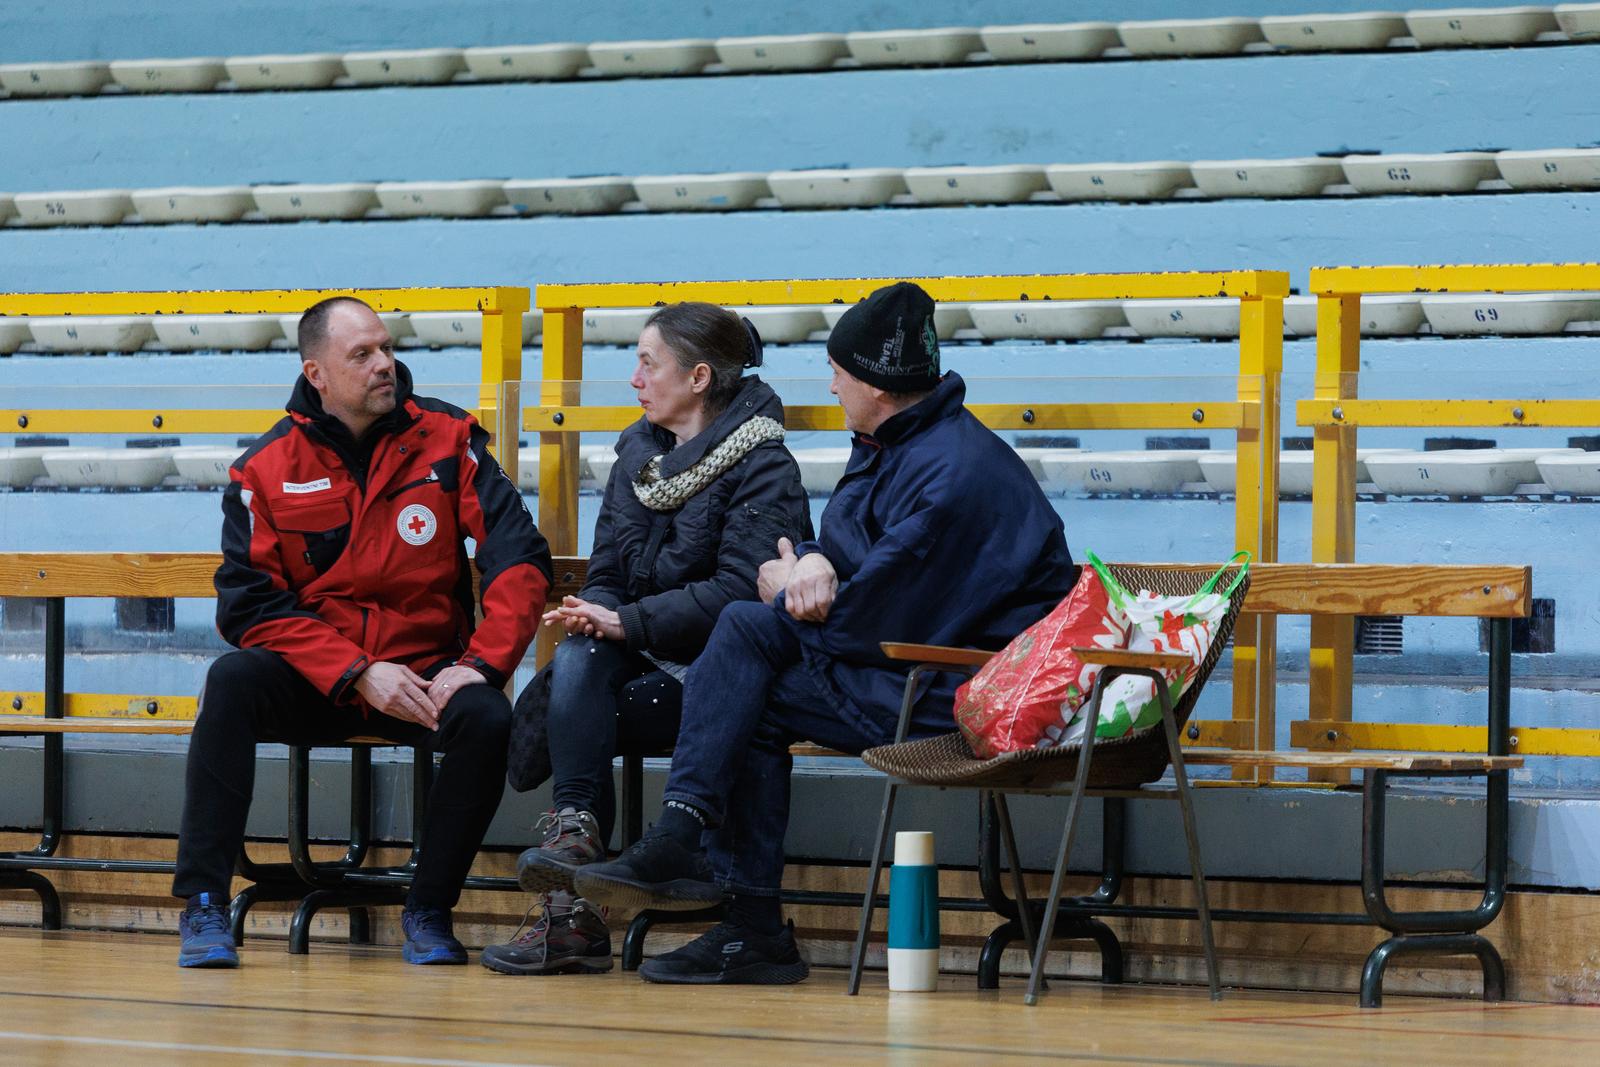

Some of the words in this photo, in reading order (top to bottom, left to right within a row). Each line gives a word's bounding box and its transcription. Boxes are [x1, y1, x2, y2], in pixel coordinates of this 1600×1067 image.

[1474, 308, 1498, 322] 69
[878, 337, 896, 366] TEAM
[1090, 467, 1112, 482] 69
[667, 800, 706, 826] Reebo
